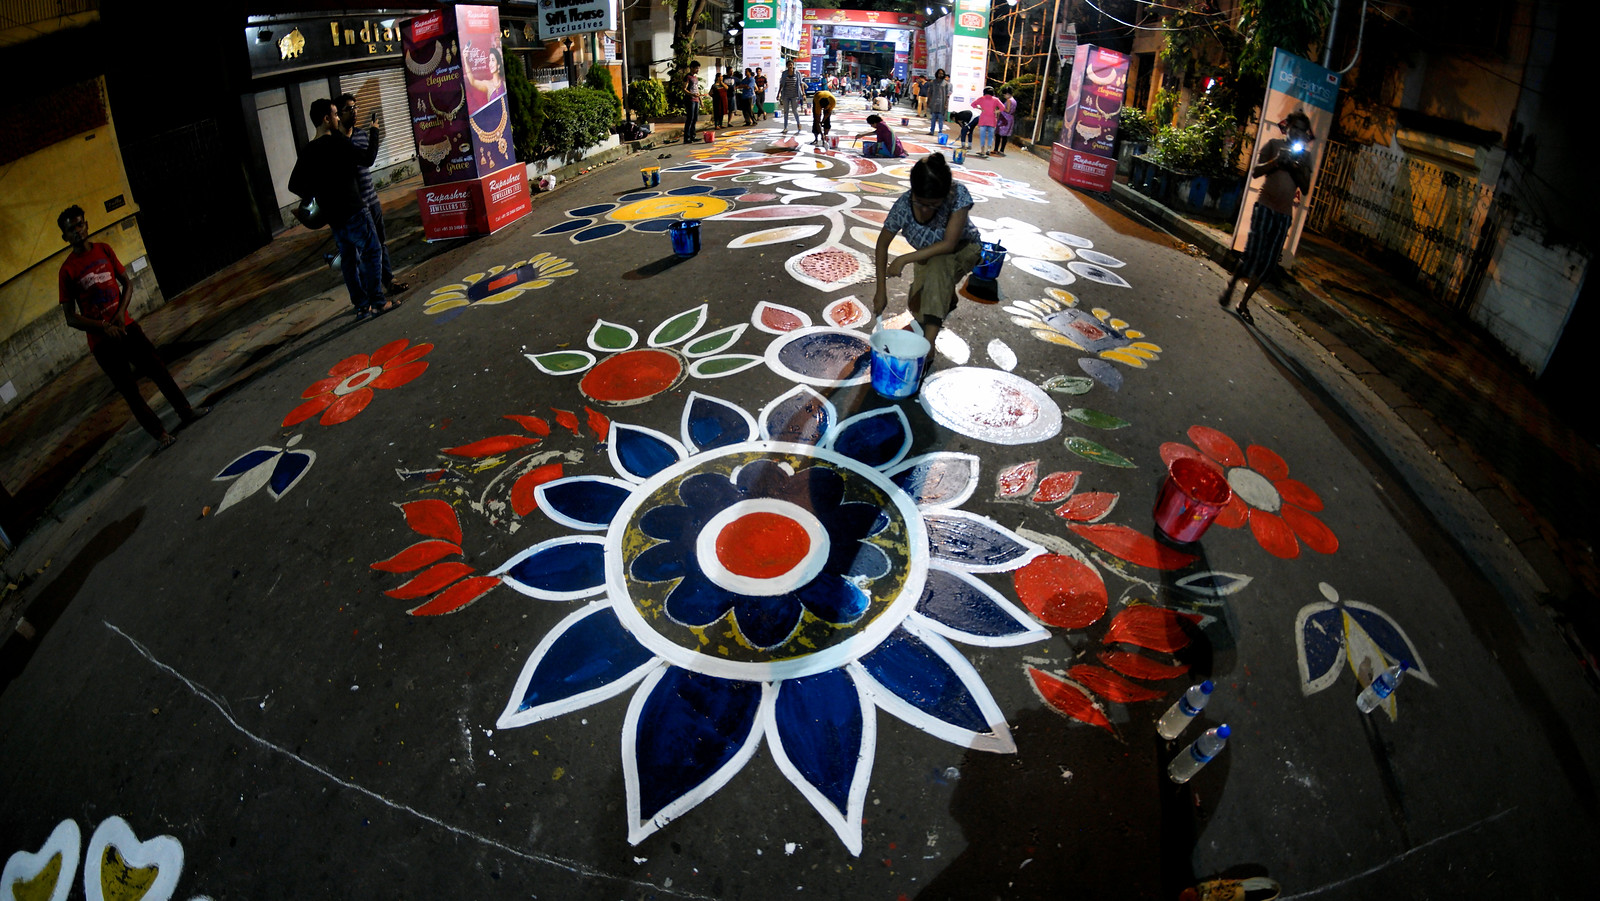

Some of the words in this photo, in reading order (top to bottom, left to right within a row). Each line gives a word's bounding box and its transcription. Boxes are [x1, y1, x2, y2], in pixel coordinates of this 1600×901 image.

[545, 10, 567, 26] Silk
[568, 8, 605, 22] House
[549, 21, 604, 34] Exclusives
[426, 72, 460, 88] Elegance
[420, 119, 444, 131] Beauty
[446, 161, 470, 176] Grace
[426, 189, 471, 204] Rupashree
